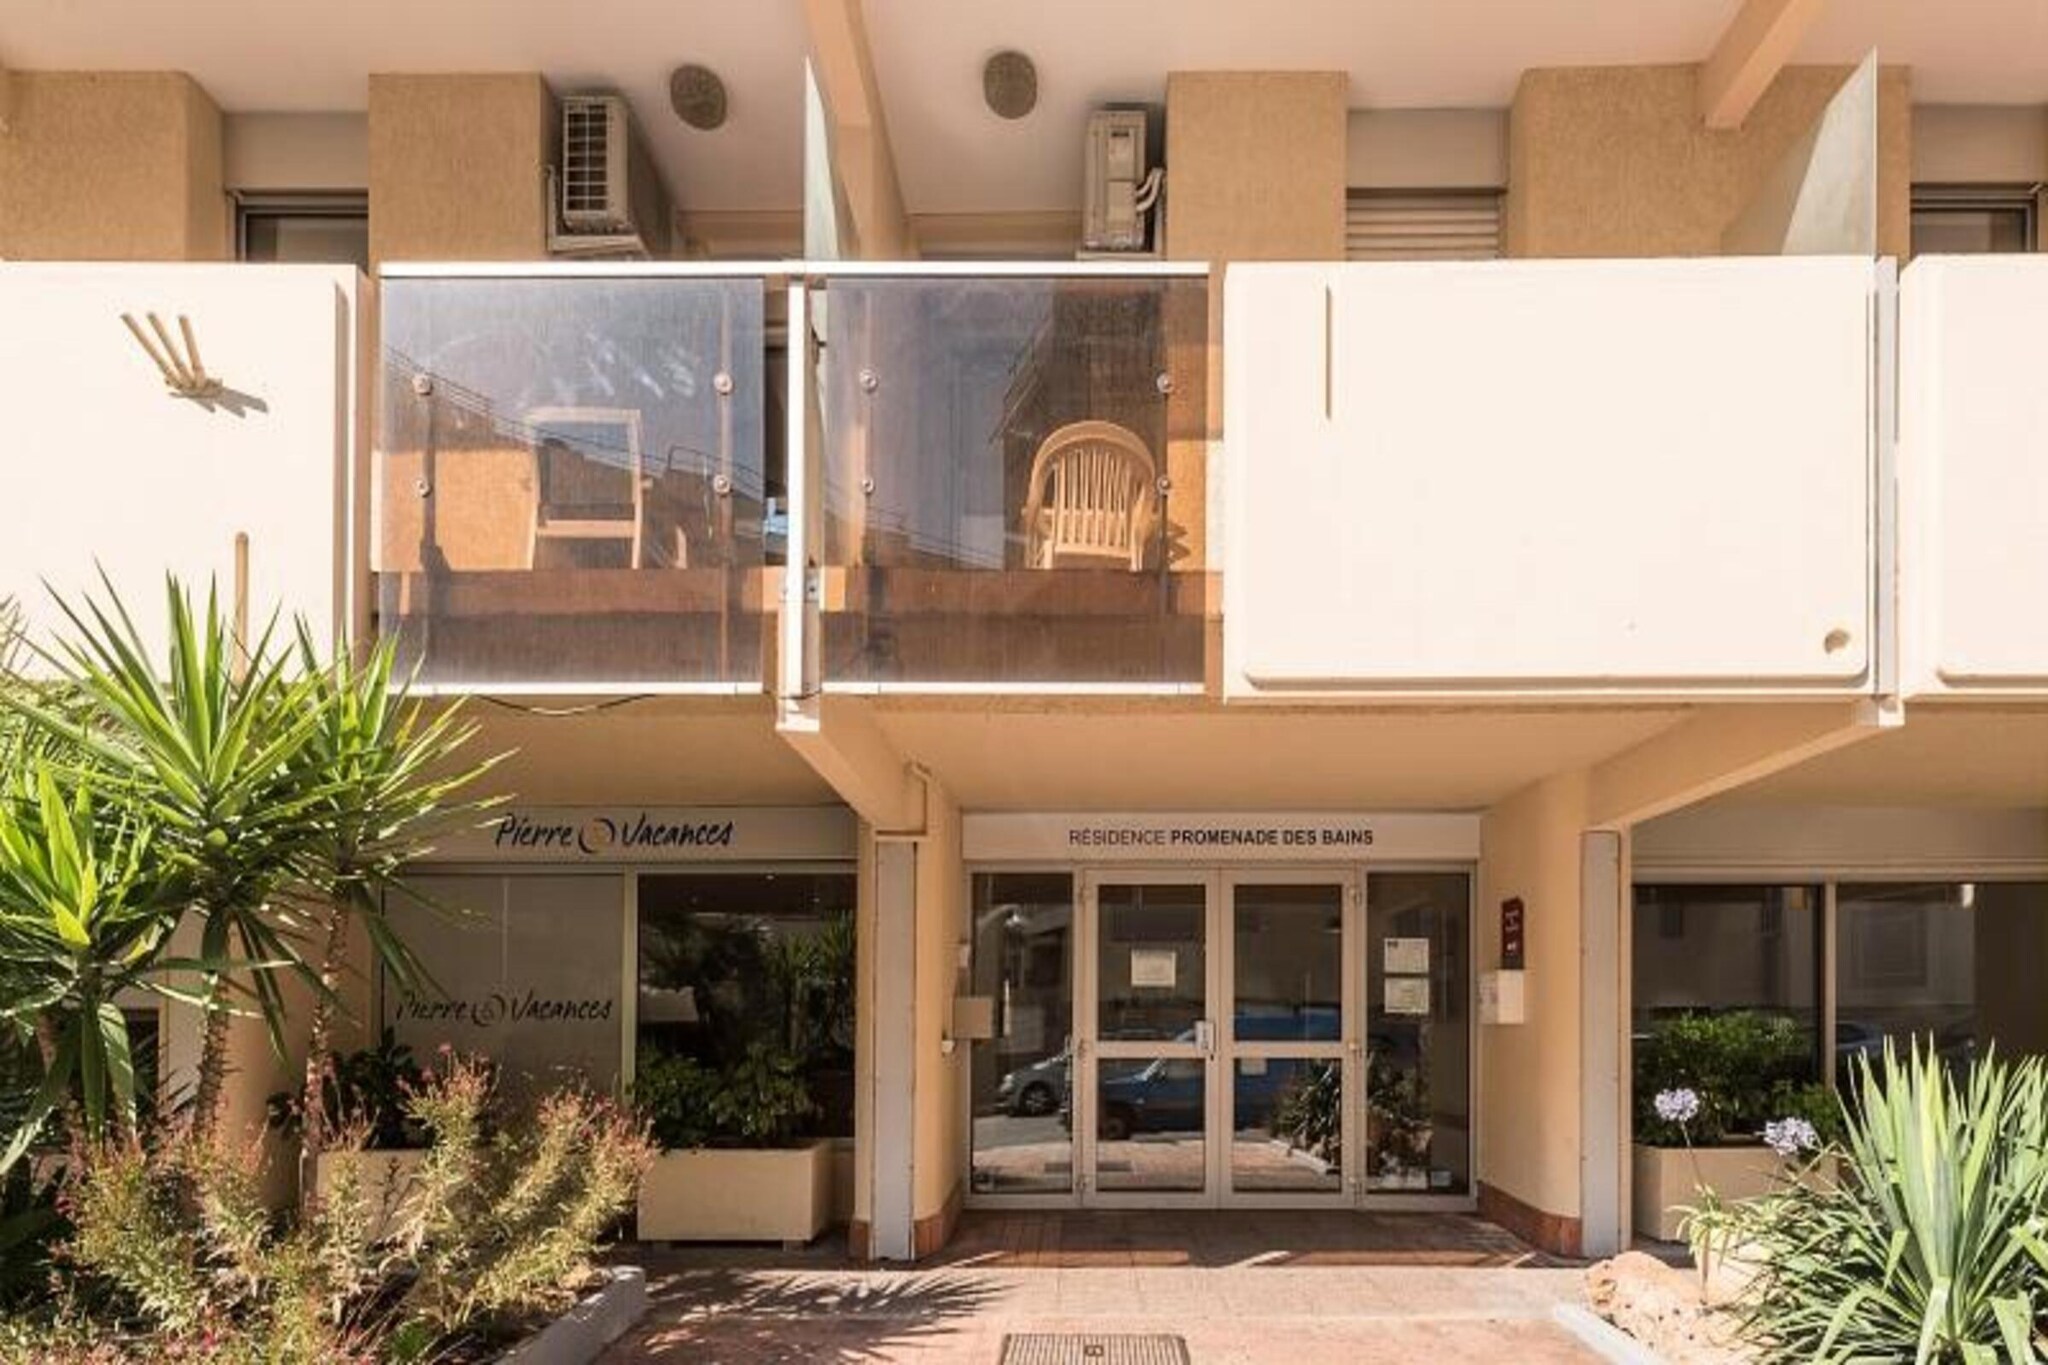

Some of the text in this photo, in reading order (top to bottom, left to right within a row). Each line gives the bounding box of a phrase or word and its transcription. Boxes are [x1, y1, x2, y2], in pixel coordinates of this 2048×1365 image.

[495, 813, 734, 847] Pierre Vacances
[1069, 827, 1375, 846] RÉSIDENCE PROMENADE DES BAINS
[511, 989, 613, 1021] Vacances
